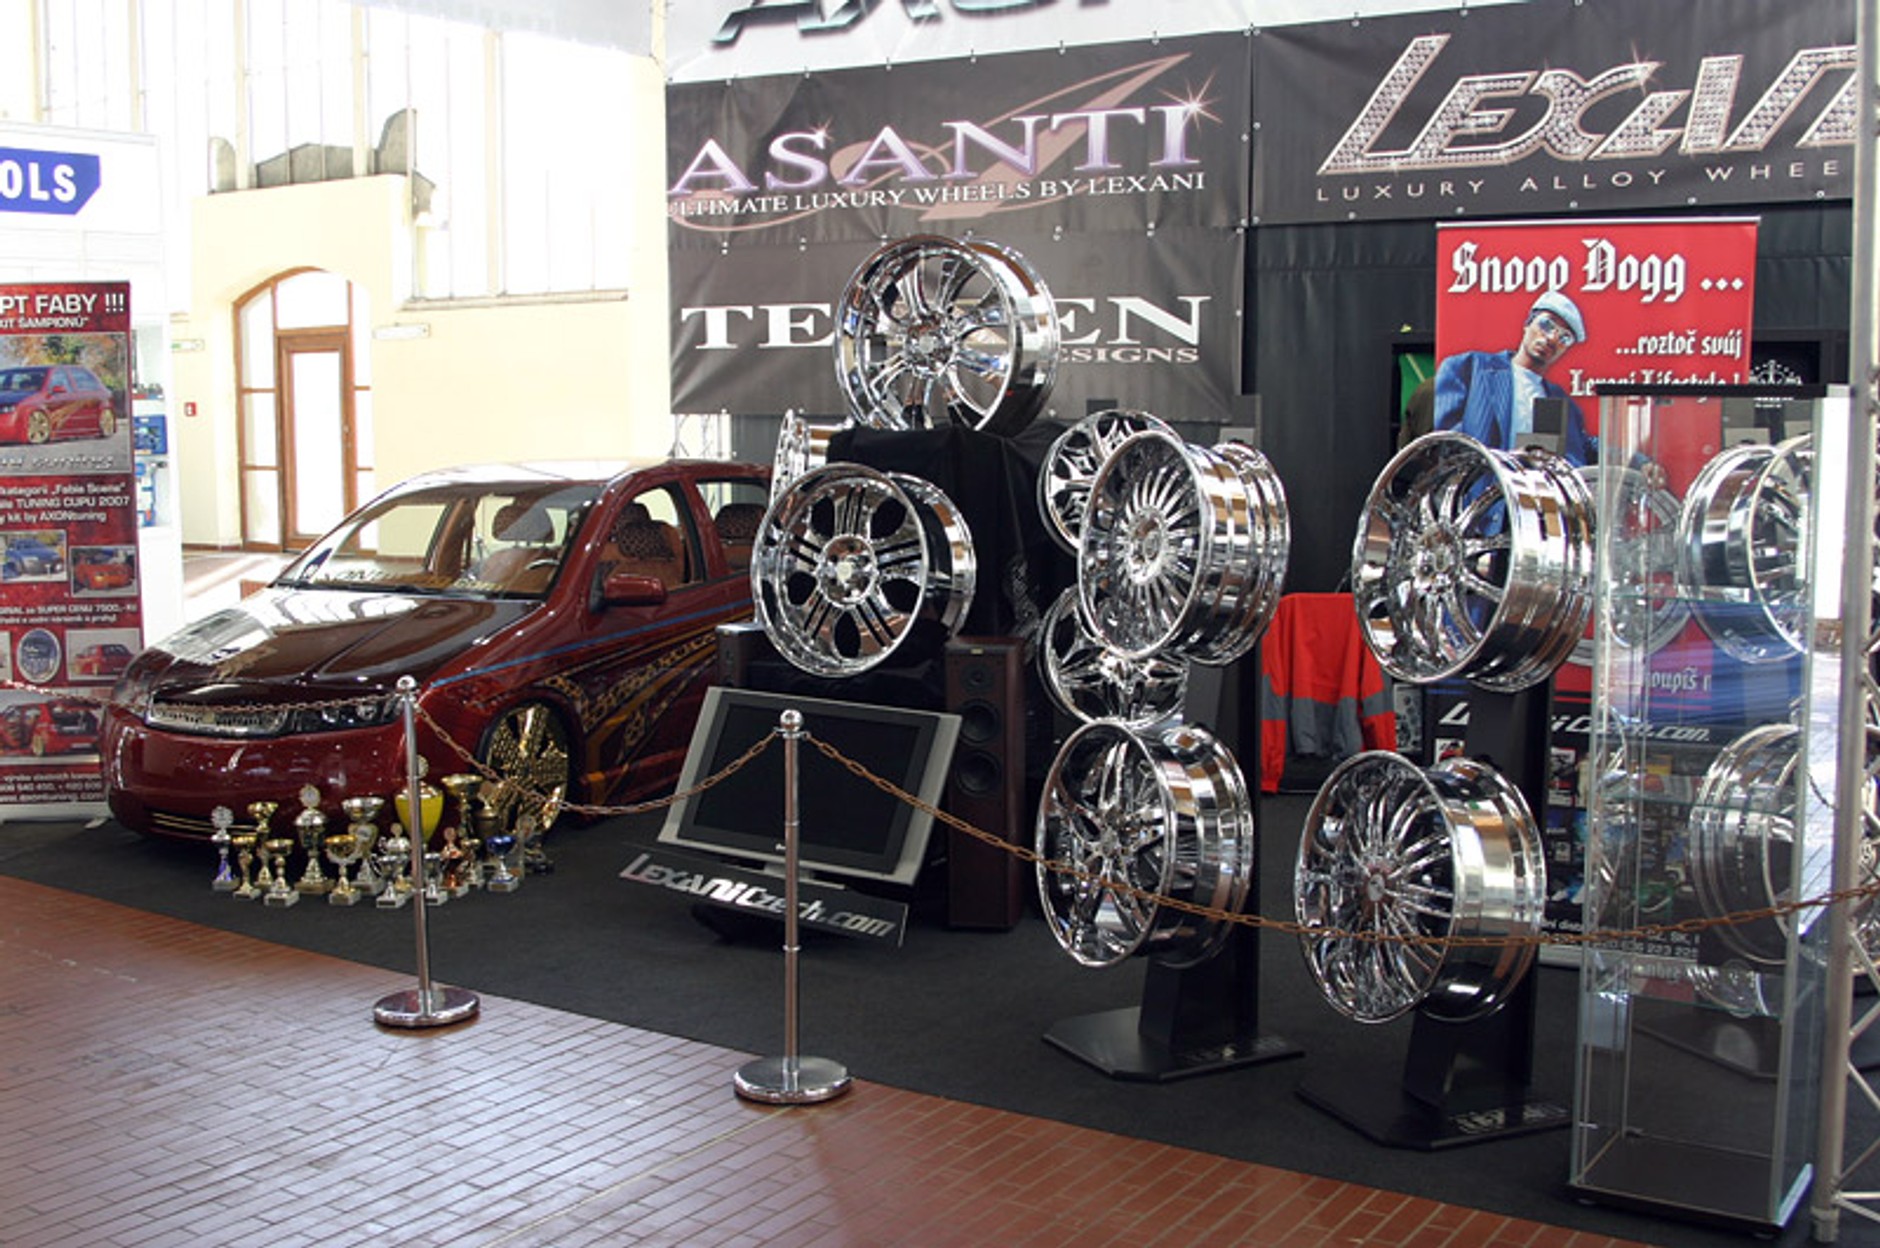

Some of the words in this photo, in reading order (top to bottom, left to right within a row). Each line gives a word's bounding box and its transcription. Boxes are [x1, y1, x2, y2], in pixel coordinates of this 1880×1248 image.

[1317, 33, 1857, 175] LEXAN
[666, 104, 1202, 197] ASANTI
[795, 188, 905, 211] LUXURY
[913, 181, 1030, 204] WHEELS
[1039, 178, 1082, 198] BY
[1087, 171, 1206, 196] LEXANI
[1317, 178, 1487, 202] LUXURY
[1519, 169, 1667, 192] ALLOY
[1705, 160, 1839, 182] WHEE
[1447, 241, 1570, 293] Snoop
[1580, 238, 1686, 303] Dogg
[35, 293, 97, 314] FABY
